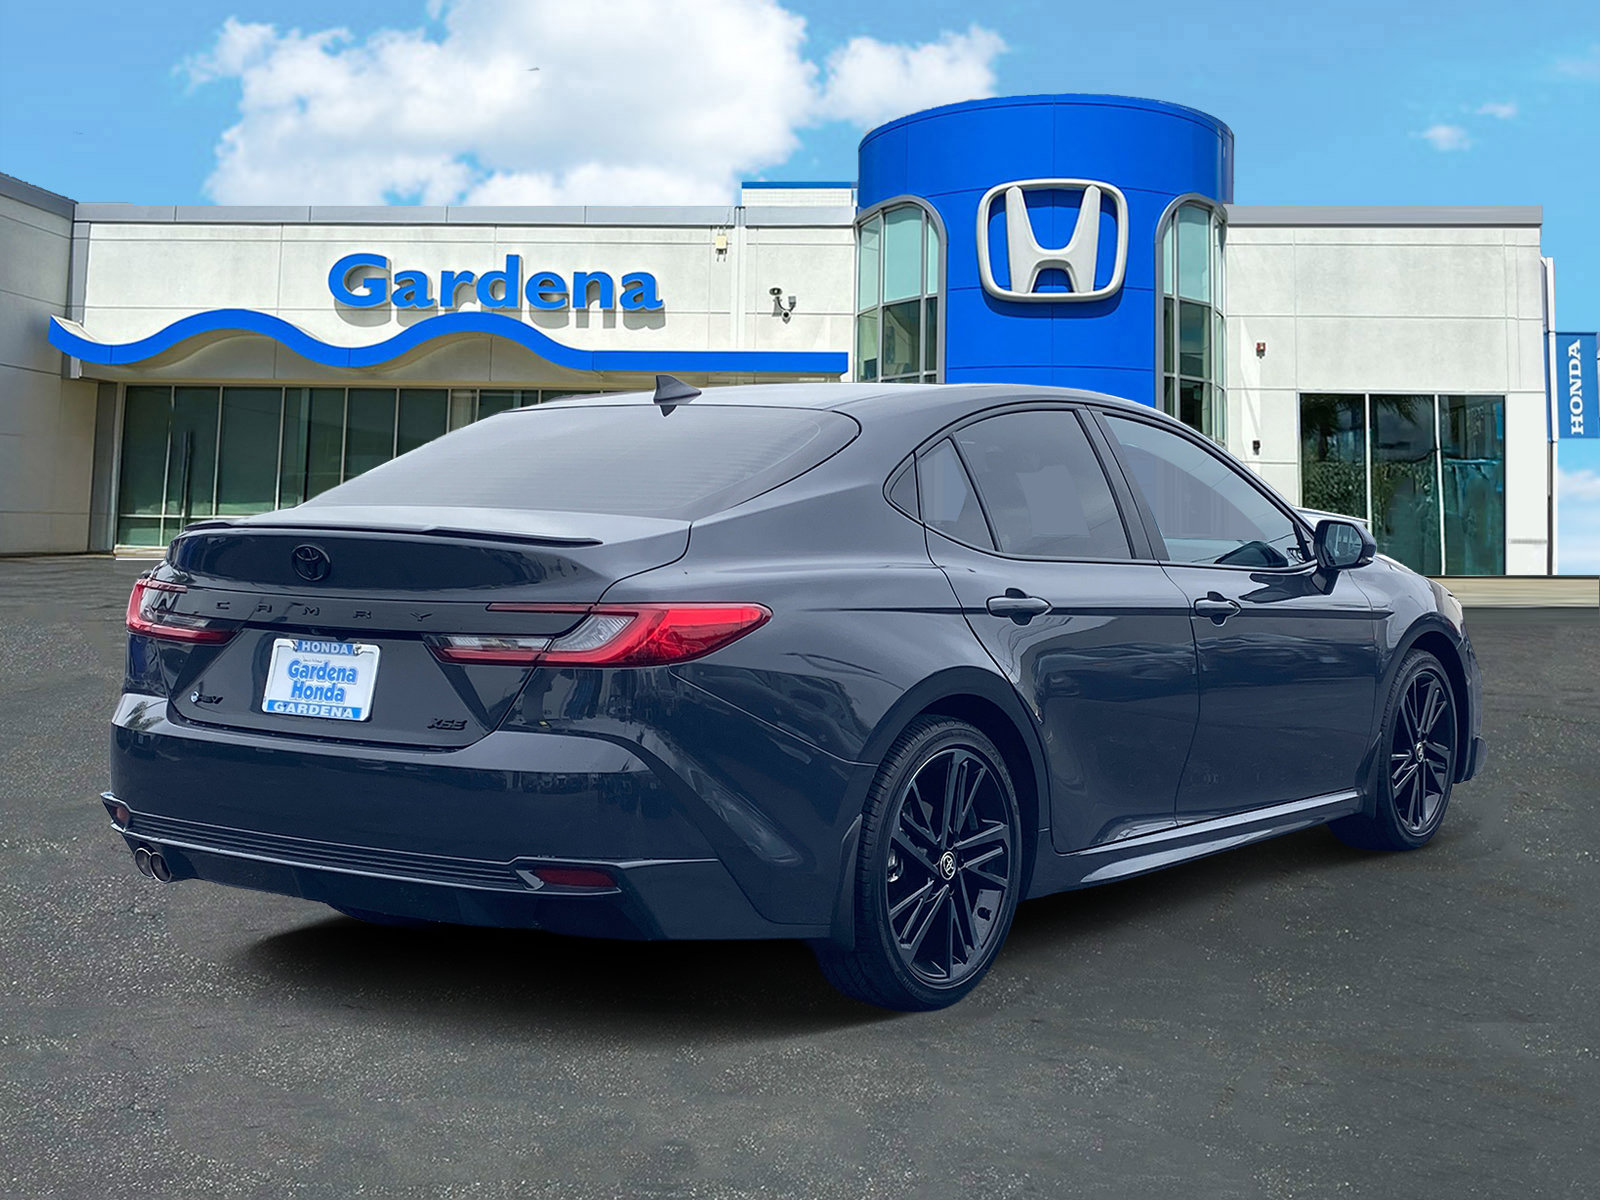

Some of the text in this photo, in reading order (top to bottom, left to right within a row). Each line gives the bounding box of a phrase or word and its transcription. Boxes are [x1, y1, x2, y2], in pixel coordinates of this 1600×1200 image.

[328, 252, 664, 310] Gardena
[1568, 339, 1584, 435] HONDA
[216, 602, 432, 621] CAMRY
[302, 641, 349, 655] HONDA
[288, 660, 357, 683] Gardena
[291, 681, 345, 702] Honda
[273, 702, 354, 718] GARDENA
